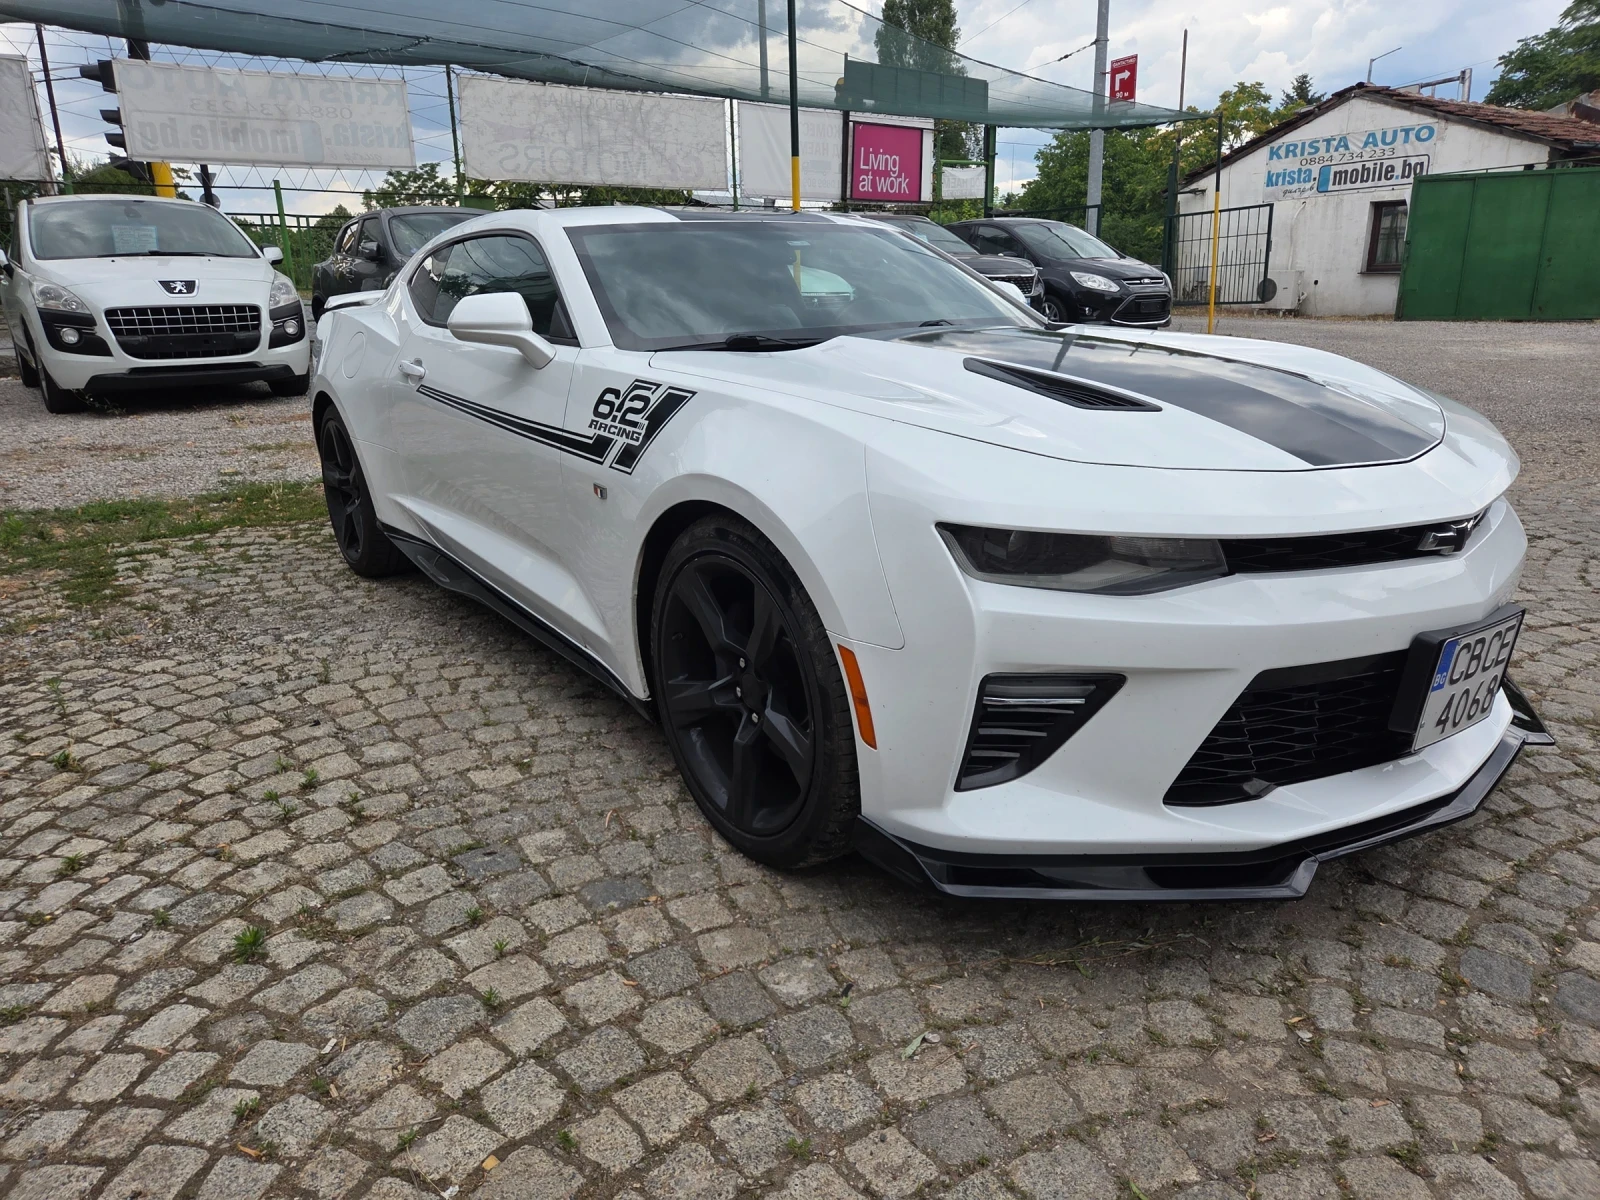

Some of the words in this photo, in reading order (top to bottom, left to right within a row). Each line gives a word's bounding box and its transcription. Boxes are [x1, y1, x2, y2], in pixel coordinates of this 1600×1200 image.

[1115, 91, 1124, 99] 90
[1268, 136, 1350, 161] KRISTA
[1361, 125, 1435, 150] AUTO
[860, 146, 900, 177] Living
[1300, 154, 1335, 167] 0884
[1338, 152, 1364, 162] 734
[1368, 147, 1396, 159] 233
[859, 171, 873, 192] at
[876, 172, 910, 194] work
[592, 387, 651, 429] 6.2
[588, 419, 643, 443] RACING
[1449, 623, 1517, 686] CBCE
[1433, 672, 1447, 687] BG
[1435, 674, 1499, 734] 4068
